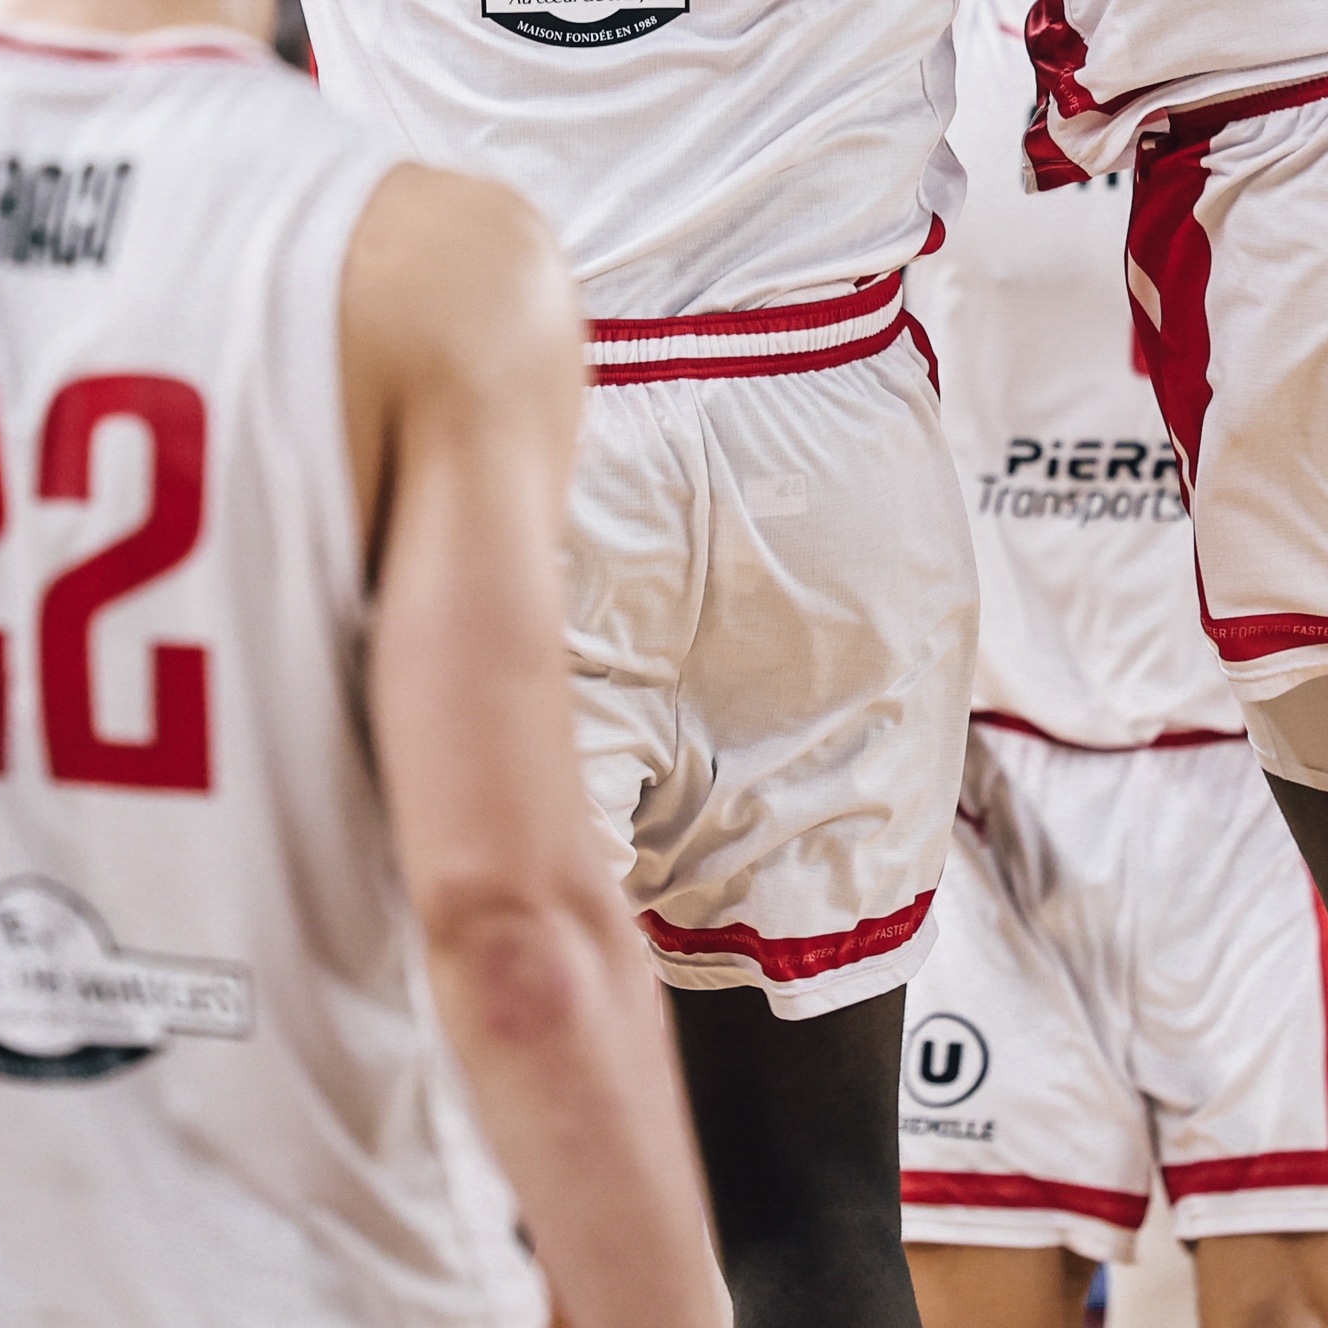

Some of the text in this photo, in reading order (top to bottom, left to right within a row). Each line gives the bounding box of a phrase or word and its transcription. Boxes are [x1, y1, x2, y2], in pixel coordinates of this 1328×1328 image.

[516, 14, 659, 44] MAISON FONDÉE EN 1988
[920, 1040, 963, 1084] U
